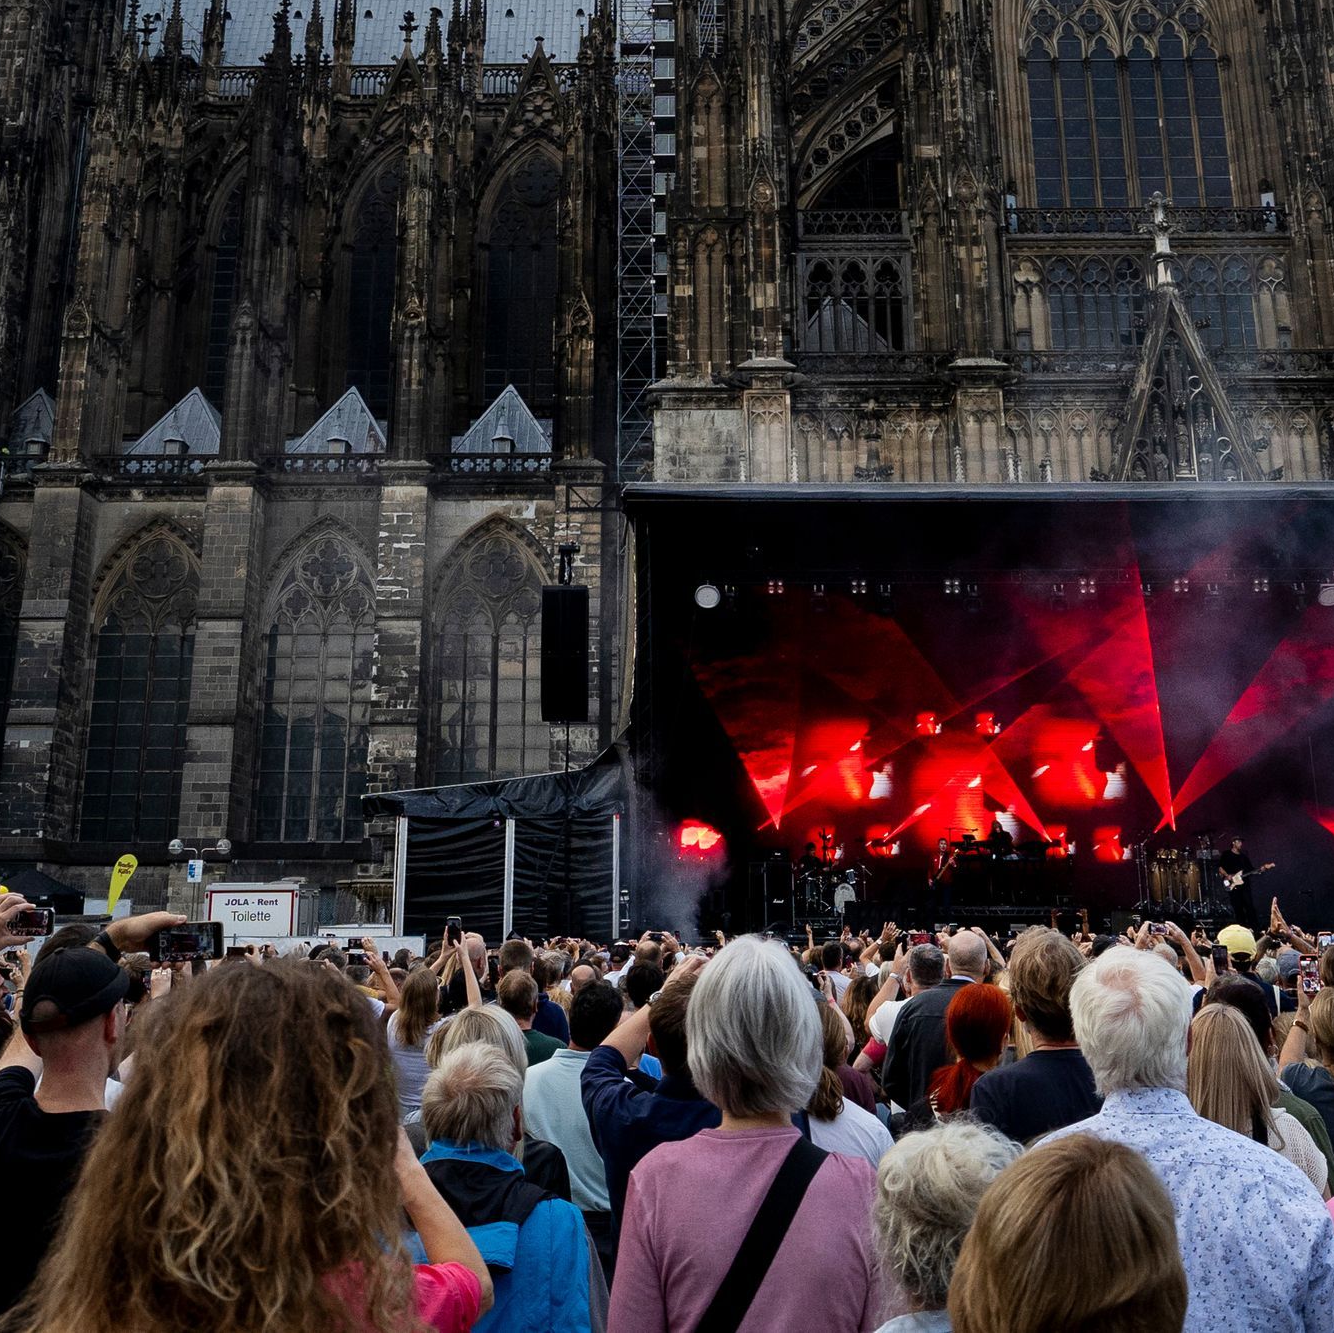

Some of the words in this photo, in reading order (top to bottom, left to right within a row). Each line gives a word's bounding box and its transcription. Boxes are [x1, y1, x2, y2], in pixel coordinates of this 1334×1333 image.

[225, 898, 249, 906] JOLA
[257, 898, 278, 906] Rent
[231, 910, 271, 922] Toilette
